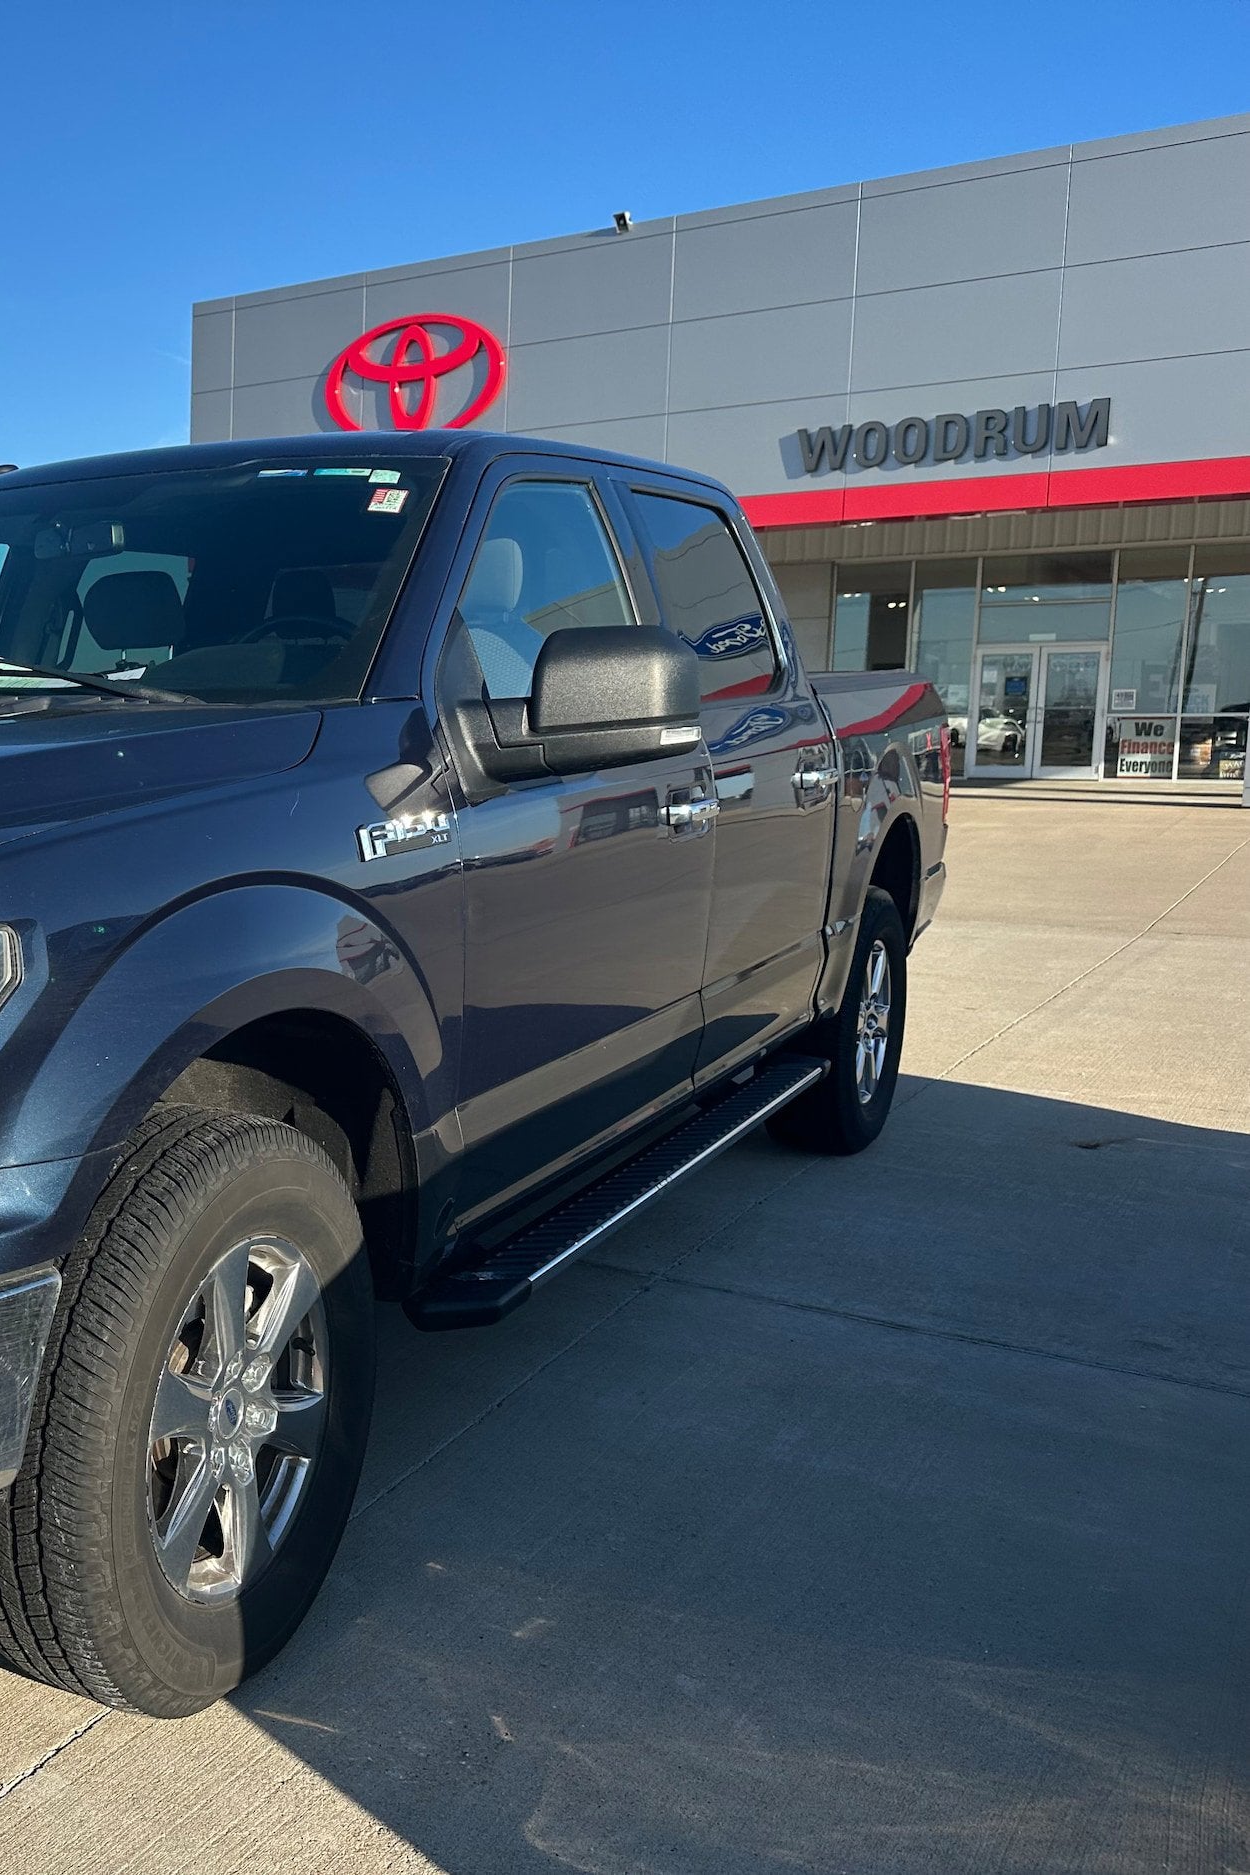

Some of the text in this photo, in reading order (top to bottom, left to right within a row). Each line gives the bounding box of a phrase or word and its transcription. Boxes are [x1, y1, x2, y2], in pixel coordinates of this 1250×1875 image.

[797, 397, 1111, 473] WOODRUM
[1134, 722, 1165, 736] We
[1120, 739, 1174, 755] Finance
[1119, 758, 1173, 774] Everyone
[432, 832, 448, 844] XLT
